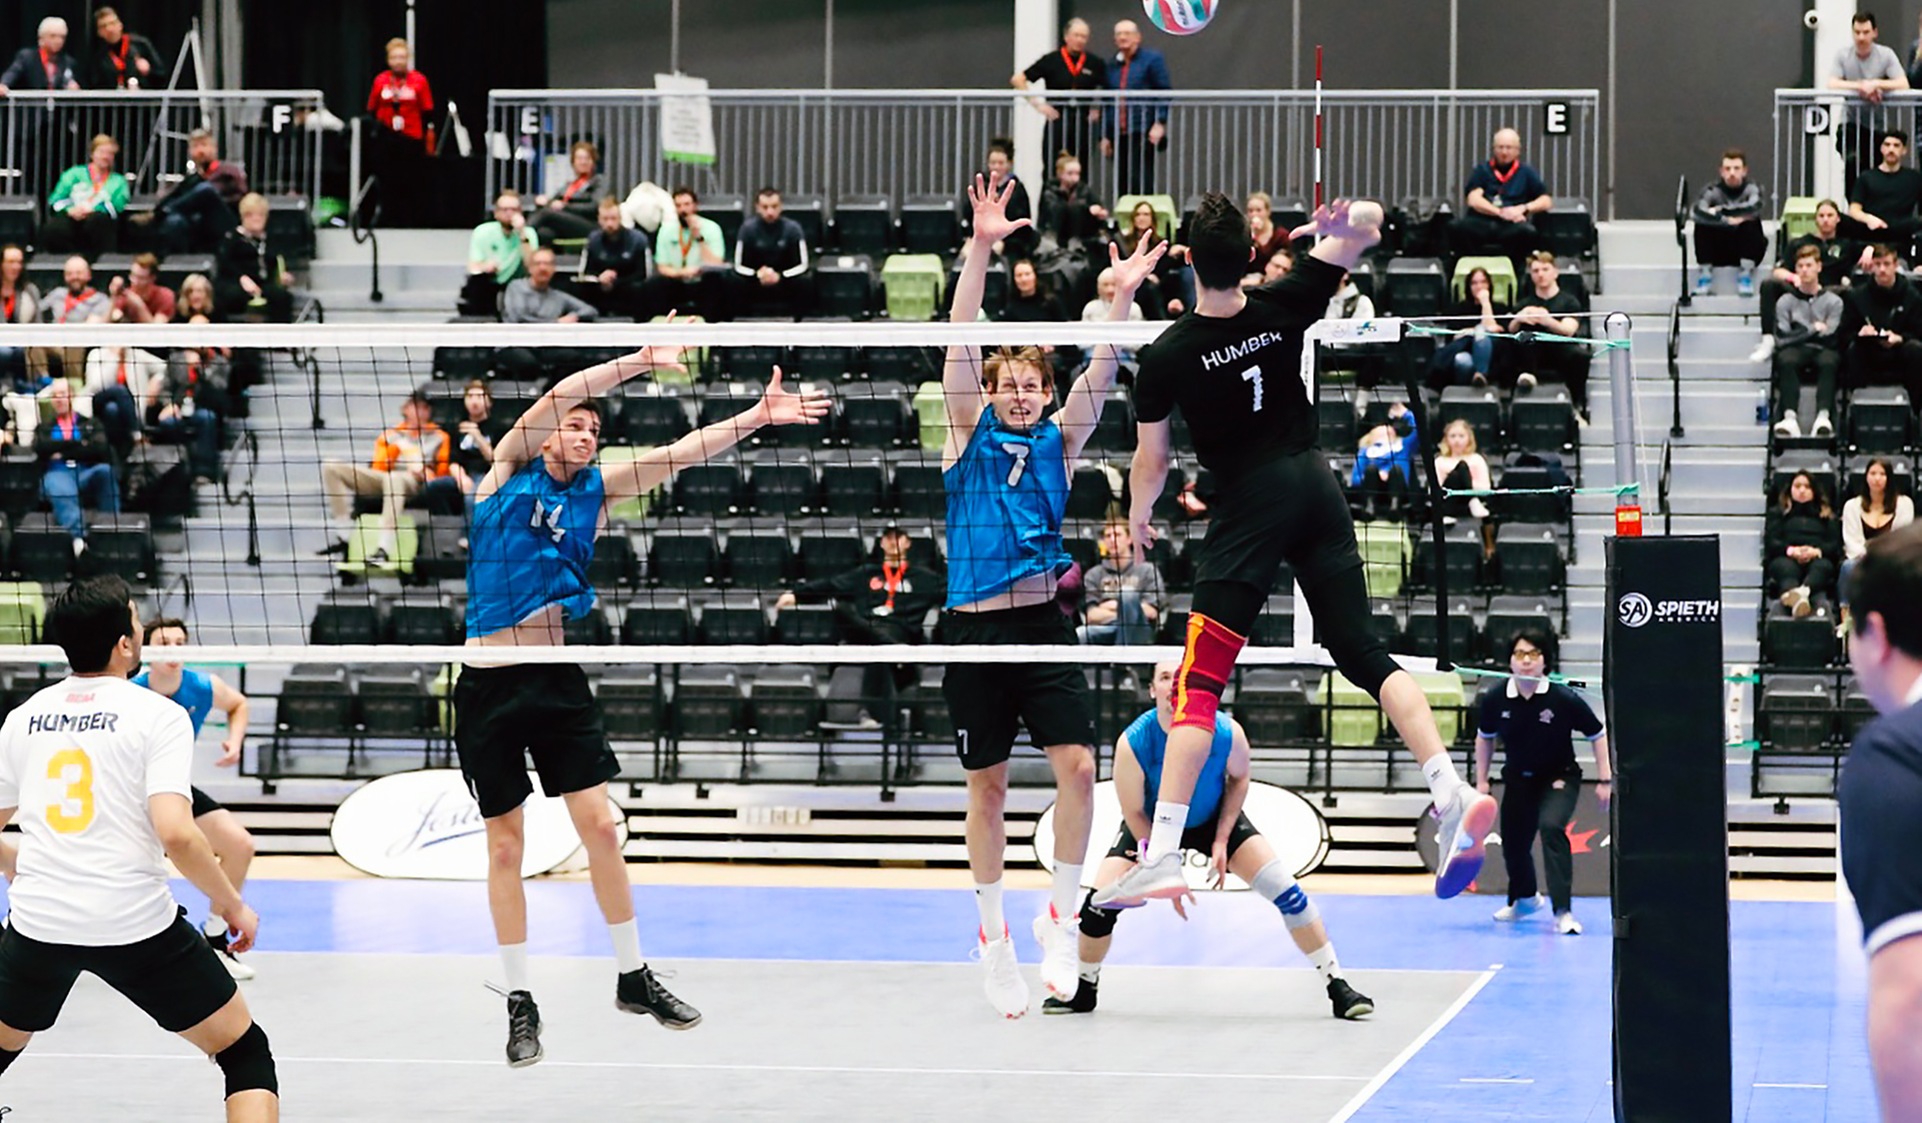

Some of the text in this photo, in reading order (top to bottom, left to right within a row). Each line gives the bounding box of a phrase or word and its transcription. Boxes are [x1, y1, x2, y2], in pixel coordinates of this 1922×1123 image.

[273, 104, 292, 134] F
[521, 106, 540, 134] E
[1547, 104, 1567, 132] E
[1805, 105, 1829, 134] D
[1002, 442, 1029, 487] 7
[1654, 600, 1719, 616] SPIETH
[28, 712, 119, 735] HUMBER
[957, 729, 969, 755] 7
[45, 747, 95, 834] 3
